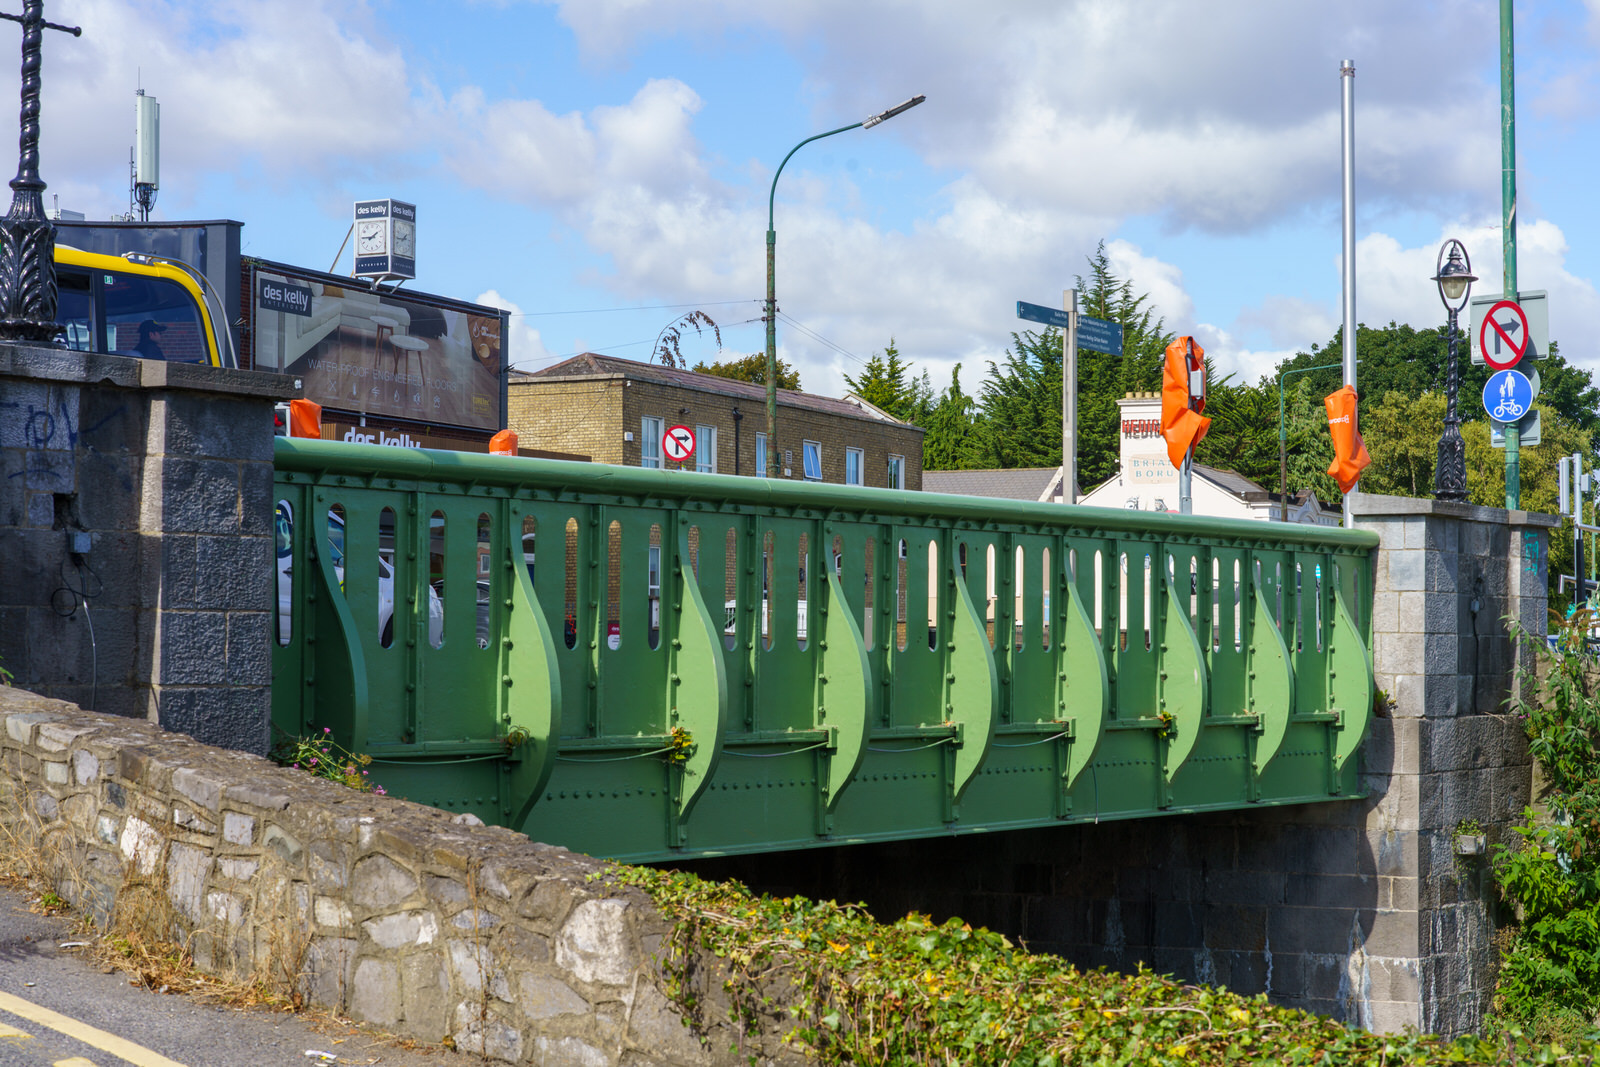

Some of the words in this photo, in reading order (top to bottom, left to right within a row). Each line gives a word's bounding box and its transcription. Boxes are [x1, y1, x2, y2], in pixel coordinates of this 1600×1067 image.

[357, 206, 370, 215] des
[370, 205, 387, 215] kelly
[393, 205, 402, 215] des
[402, 208, 415, 220] kelly
[263, 284, 282, 301] des
[284, 287, 309, 312] kelly
[307, 358, 370, 378] WATER-PROOF
[372, 368, 424, 387] ENGINEERED
[426, 377, 458, 393] FLOORS
[1122, 419, 1160, 434] HEDIG
[378, 431, 421, 448] kell
[1135, 469, 1174, 479] BORU
